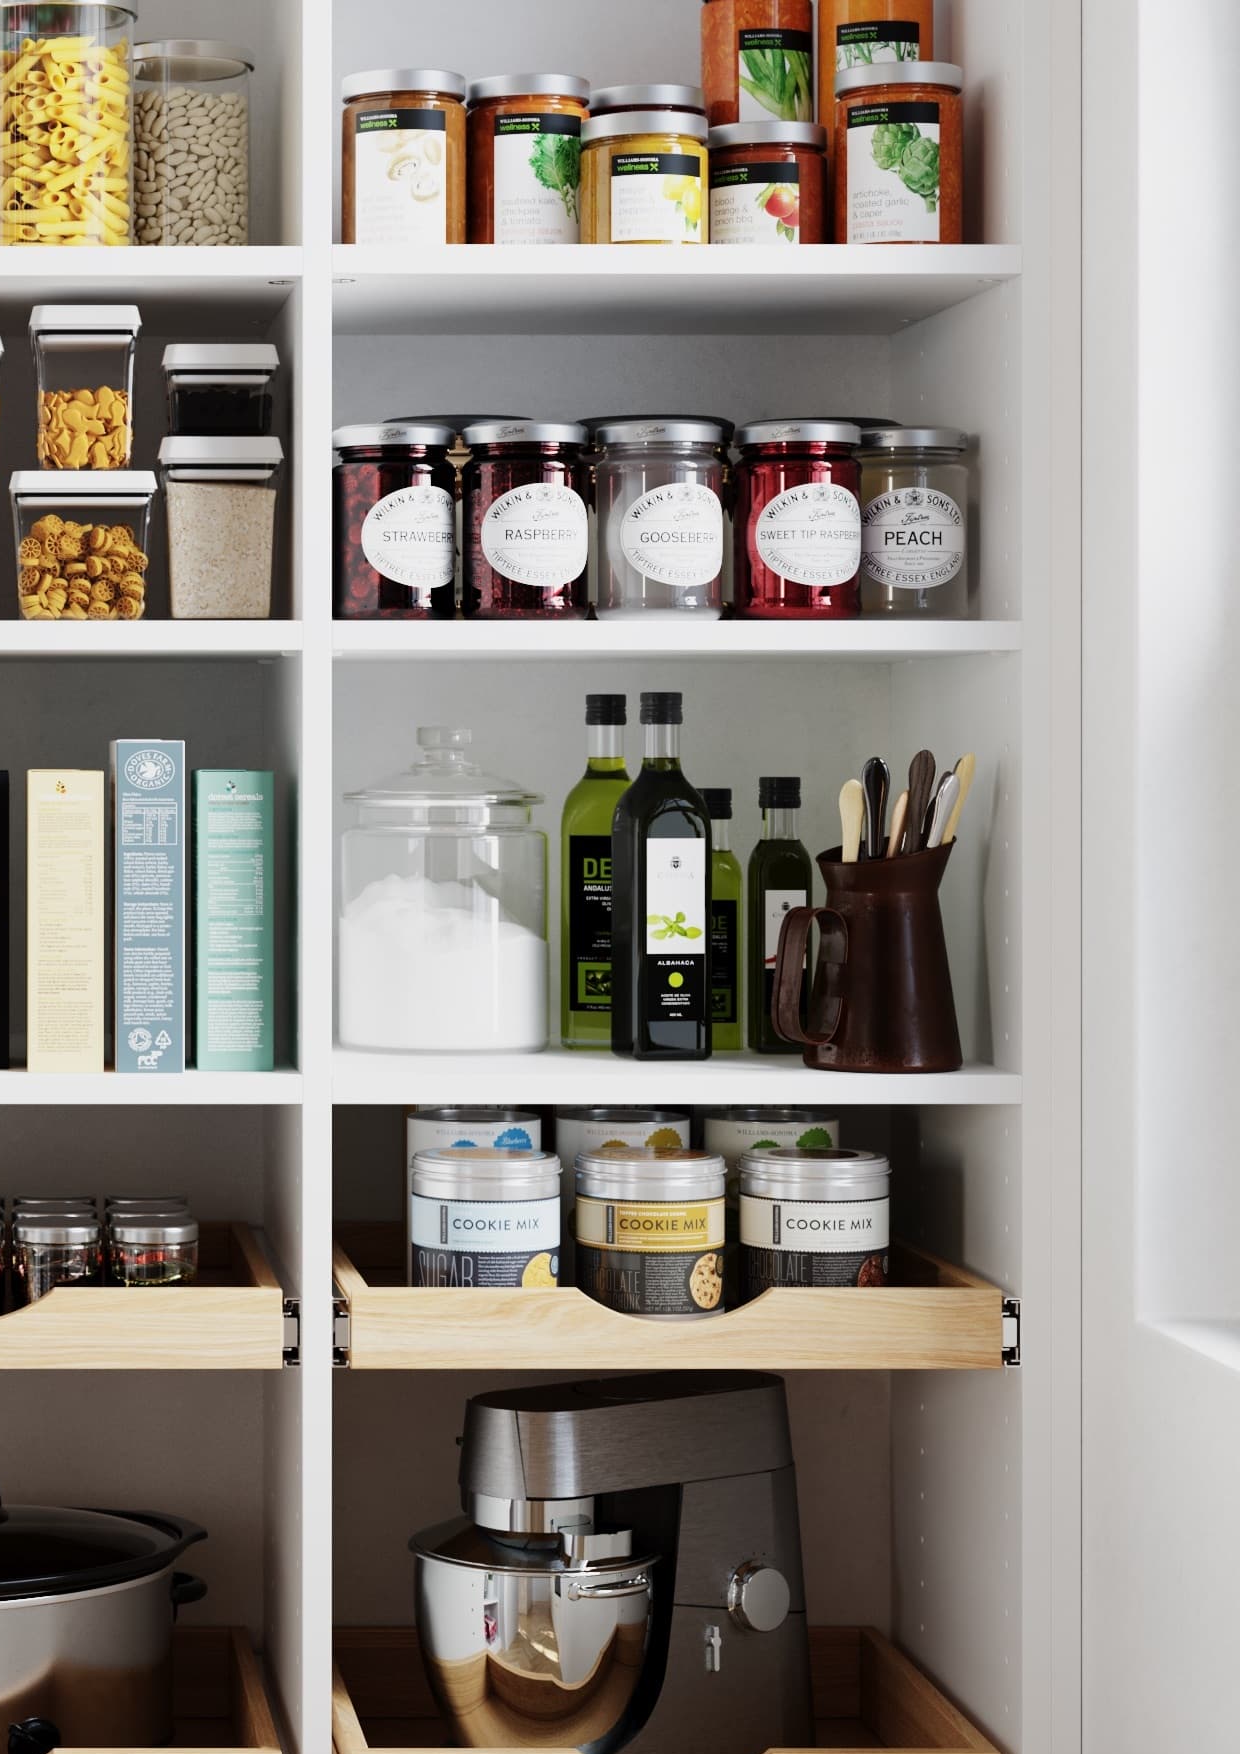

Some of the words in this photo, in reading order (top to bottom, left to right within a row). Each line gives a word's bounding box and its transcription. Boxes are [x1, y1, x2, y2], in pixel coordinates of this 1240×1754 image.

[360, 121, 387, 129] wellness
[500, 124, 530, 132] wellness
[617, 163, 649, 172] wellness
[714, 196, 735, 206] blood
[373, 496, 405, 521] WILKIN
[492, 494, 522, 519] WILKIN
[525, 491, 532, 500] &
[632, 494, 664, 519] WILKIN
[667, 491, 673, 500] &
[767, 494, 798, 519] WILKIN
[802, 491, 808, 500] &
[833, 490, 851, 508] SONS
[863, 498, 892, 524] WILKIN
[894, 495, 901, 504] &
[927, 495, 950, 513] SONS
[949, 507, 961, 525] LTD
[383, 531, 453, 543] STRAWBERR
[505, 529, 577, 540] RASPBERRY
[760, 530, 796, 541] SWEET
[801, 529, 817, 540] TIP
[884, 531, 943, 546] PEACH
[493, 551, 524, 576] TIPTREE
[633, 550, 664, 576] TIPTREE
[768, 551, 800, 577] TIPTREE
[803, 569, 833, 579] ESSEX
[863, 555, 893, 579] TIPTREE
[895, 573, 928, 583] ESSEX
[930, 553, 961, 581] ENGLAND
[127, 752, 152, 772] DOVES
[153, 752, 172, 772] FARM
[130, 772, 171, 788] ORGANIC
[583, 857, 612, 878] DE
[737, 1129, 798, 1137] WILLIAMS-SONOMA
[452, 1218, 511, 1231] COOKIE
[516, 1218, 540, 1230] MIX
[619, 1218, 678, 1231] COOKIE
[683, 1218, 707, 1230] MIX
[786, 1218, 845, 1231] COOKIE
[850, 1218, 873, 1230] MIX
[418, 1251, 474, 1287] SUGAR
